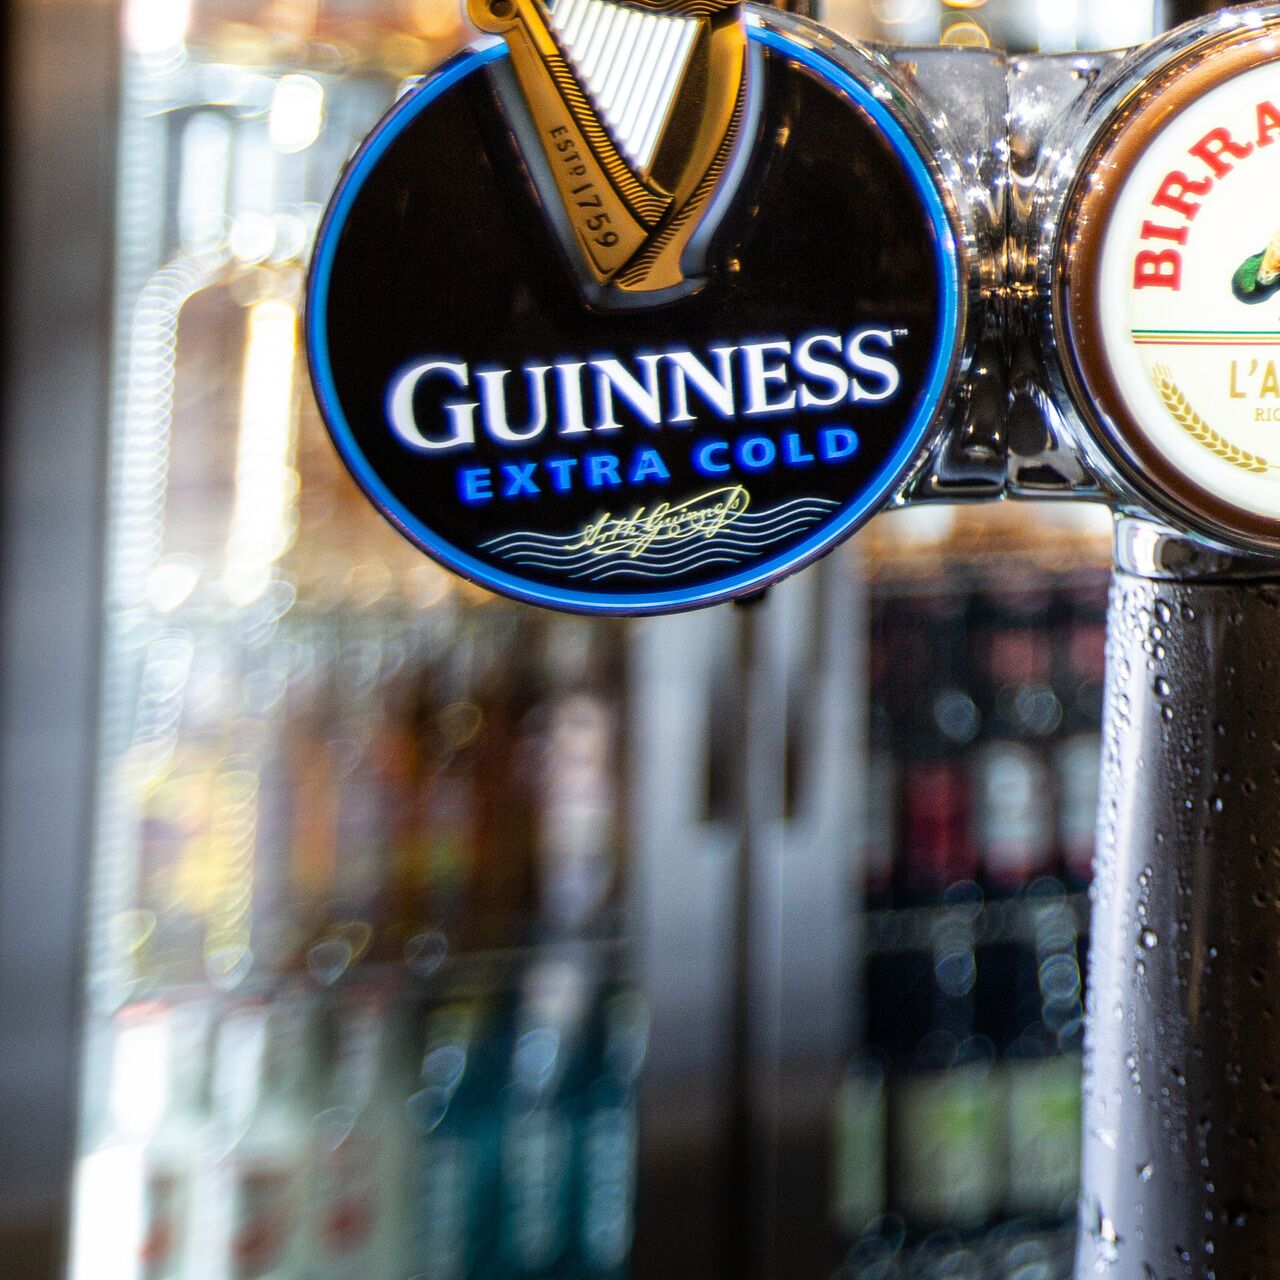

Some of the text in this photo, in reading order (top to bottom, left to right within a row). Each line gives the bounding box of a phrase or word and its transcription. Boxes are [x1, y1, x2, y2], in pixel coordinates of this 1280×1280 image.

[571, 183, 620, 248] 1759
[389, 328, 900, 451] GUINNESS
[465, 427, 859, 501] EXTRA COLD
